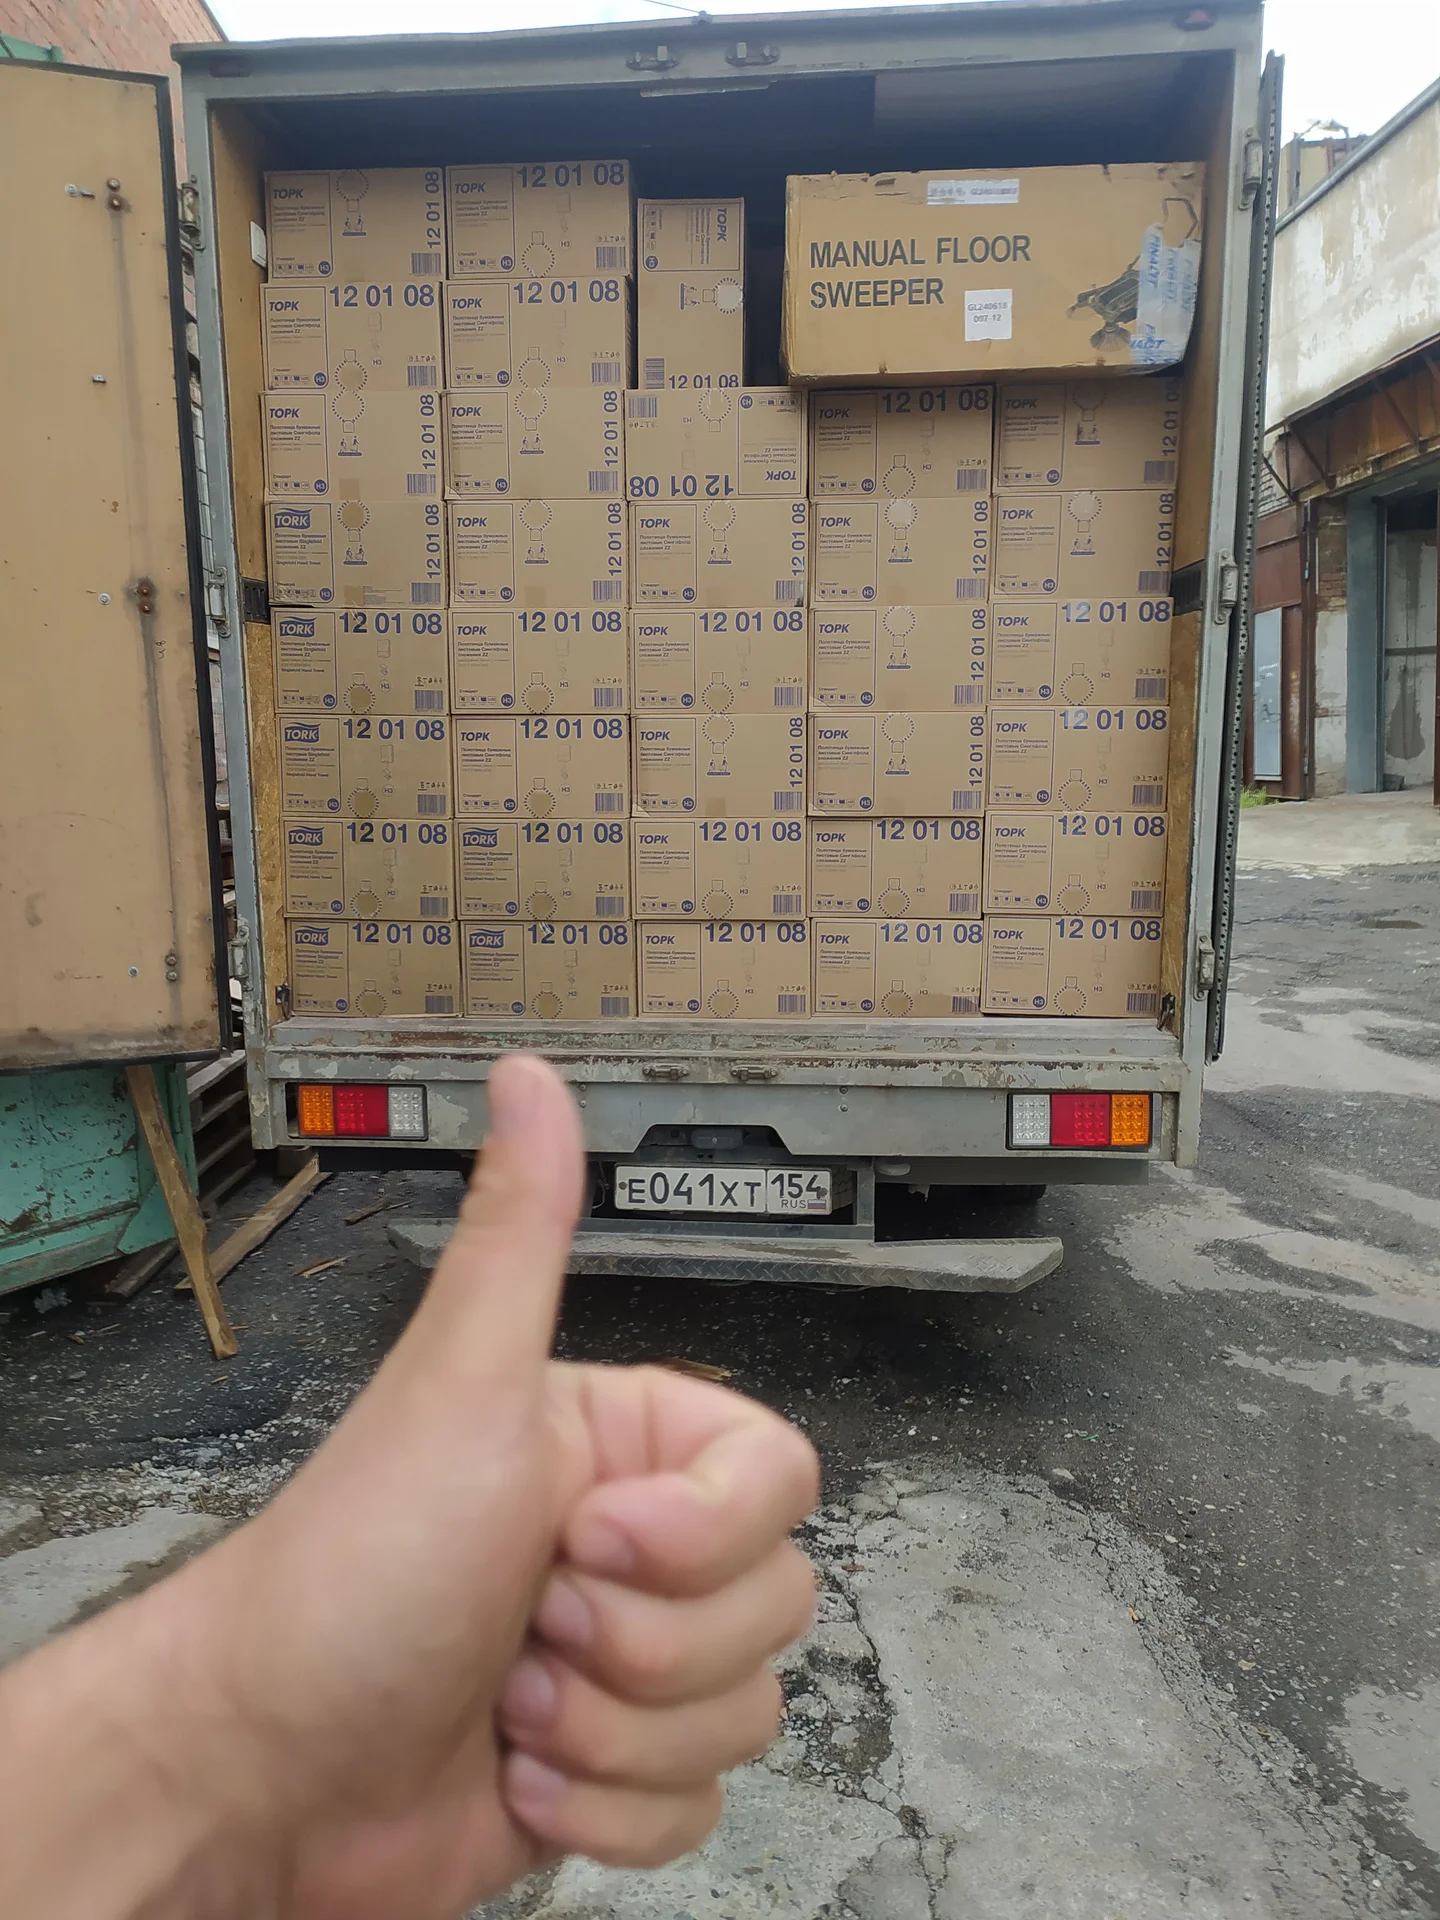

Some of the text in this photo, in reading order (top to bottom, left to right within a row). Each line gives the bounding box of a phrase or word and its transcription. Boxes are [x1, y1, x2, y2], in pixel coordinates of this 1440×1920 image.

[518, 161, 624, 188] 12 01 08
[273, 187, 304, 200] ТОРК
[455, 182, 486, 194] ТОРК
[424, 169, 441, 249] 12 01 08
[717, 208, 728, 242] ТОРК
[810, 235, 1031, 268] MANUAL FLOOR
[330, 284, 434, 307] 12 01 08
[513, 279, 620, 304] 12 01 08
[810, 278, 944, 308] SWEEPER
[269, 301, 299, 312] ТОРК
[452, 298, 482, 309] ТОРК
[669, 374, 739, 389] 12 01 08
[882, 388, 989, 414] 12 01 08
[269, 408, 299, 418] ТОРК
[451, 407, 481, 417] ТОРК
[818, 407, 850, 420] ТОРК
[420, 394, 436, 470] 12 01 08
[603, 391, 618, 467] 12 01 08
[765, 470, 796, 481] ТОРК
[629, 475, 734, 497] 12 01 08
[276, 515, 308, 526] TORK
[457, 517, 487, 527] ТОРК
[820, 517, 852, 527] ТОРК
[1002, 510, 1034, 520] ТОРК
[640, 518, 670, 528] ТОРК
[425, 504, 441, 579] 12 01 08
[607, 503, 622, 576] 12 01 08
[791, 503, 806, 576] 12 01 08
[972, 500, 988, 574] 12 01 08
[1061, 601, 1170, 623] 12 01 08
[518, 611, 622, 632] 12 01 08
[699, 611, 803, 632] 12 01 08
[997, 617, 1029, 627] ТОРК
[281, 624, 313, 634] TORK
[457, 626, 487, 635] ТОРК
[638, 626, 668, 636] ТОРК
[819, 624, 850, 634] ТОРК
[970, 609, 986, 681] 12 01 08
[1059, 709, 1167, 730] 12 01 08
[286, 729, 317, 740] TORK
[343, 718, 445, 740] 12 01 08
[520, 718, 623, 739] 12 01 08
[818, 730, 849, 739] ТОРК
[996, 723, 1027, 732] ТОРК
[461, 732, 490, 741] ТОРК
[640, 731, 670, 741] ТОРК
[789, 717, 803, 787] 12 01 08
[969, 716, 984, 787] 12 01 08
[347, 822, 447, 844] 12 01 08
[522, 822, 623, 843] 12 01 08
[699, 822, 802, 841] 12 01 08
[877, 819, 980, 840] 12 01 08
[995, 828, 1026, 837] ТОРК
[290, 832, 321, 843] TORK
[464, 834, 496, 844] TORK
[639, 835, 669, 844] ТОРК
[816, 833, 846, 842] ТОРК
[352, 922, 451, 945] 12 01 08
[705, 922, 806, 943] 12 01 08
[880, 923, 984, 944] 12 01 08
[993, 930, 1024, 940] ТОРК
[1055, 918, 1161, 941] 12 01 08
[296, 932, 327, 943] TORK
[471, 935, 502, 946] TORK
[646, 935, 675, 945] ТОРК
[820, 935, 850, 944] ТОРК
[771, 1173, 824, 1200] 154
[781, 1199, 807, 1209] RUS
